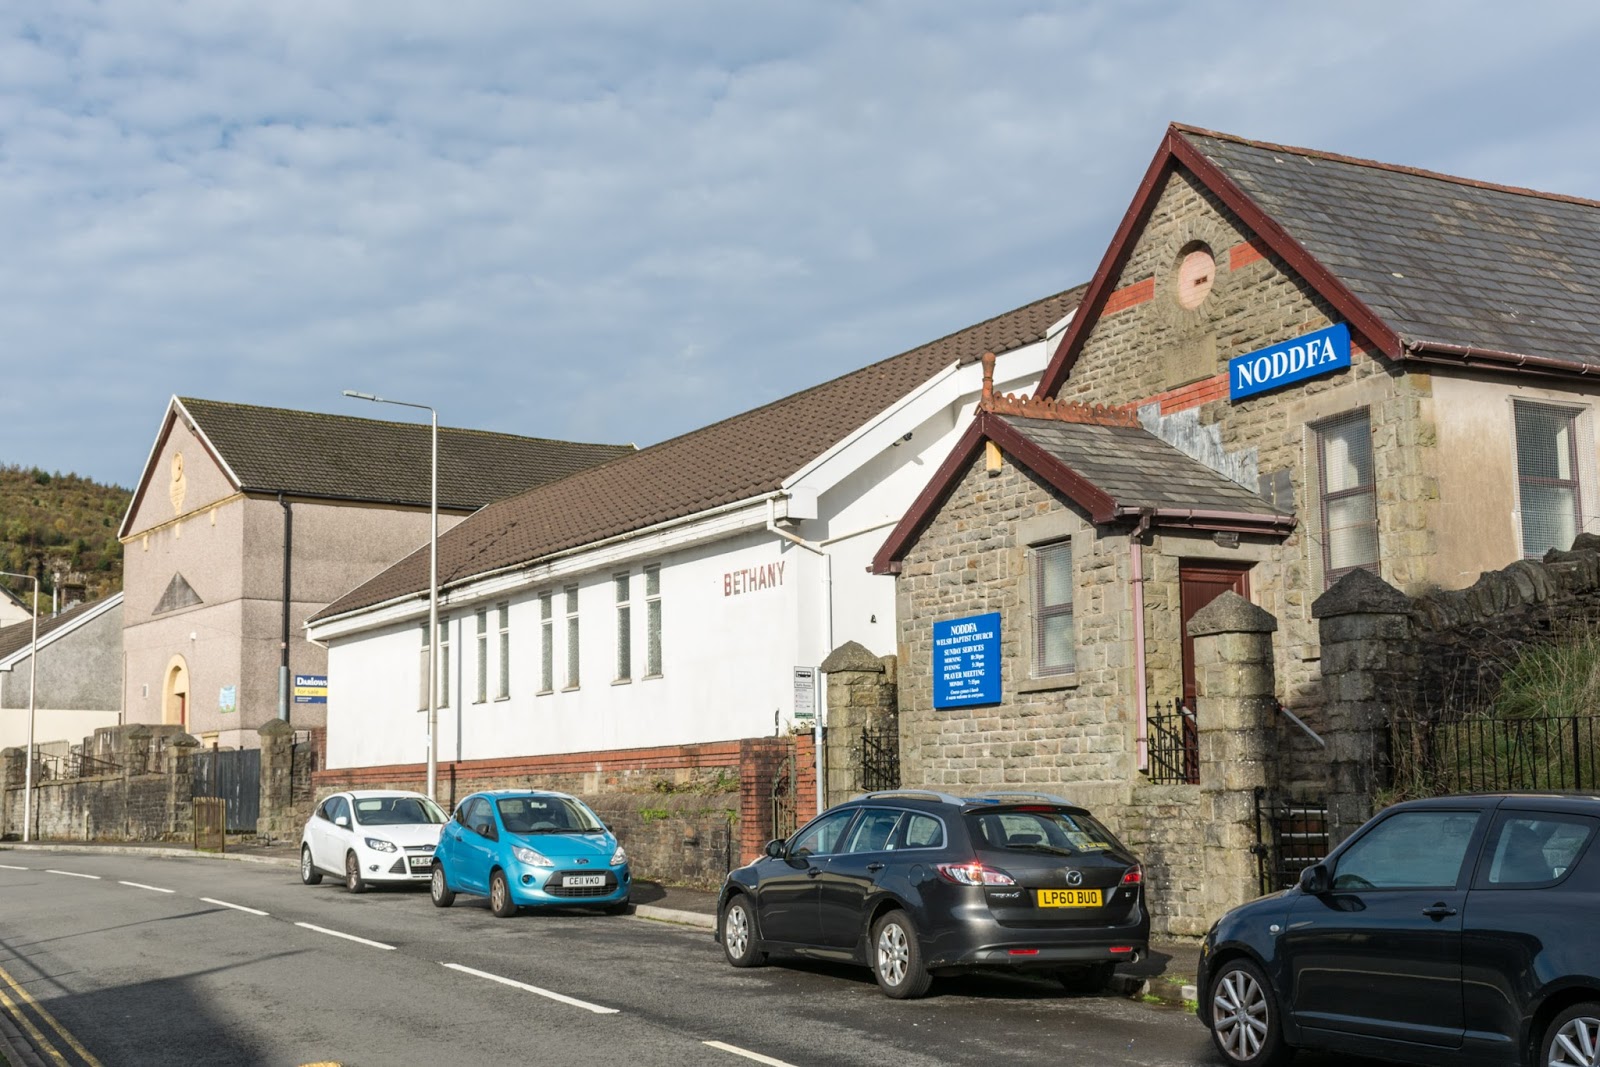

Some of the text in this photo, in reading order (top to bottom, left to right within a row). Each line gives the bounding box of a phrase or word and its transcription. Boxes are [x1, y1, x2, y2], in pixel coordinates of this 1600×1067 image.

[1237, 336, 1338, 390] NODDFA
[724, 560, 785, 597] BETHANY
[951, 623, 977, 636] NODDFA
[936, 632, 993, 646] WELSH BAPTIST CHURCH
[962, 644, 984, 653] SERVICES
[944, 669, 985, 680] PRAYER MEETING
[569, 877, 584, 885] CE11
[1043, 891, 1097, 904] LP60 BUO
